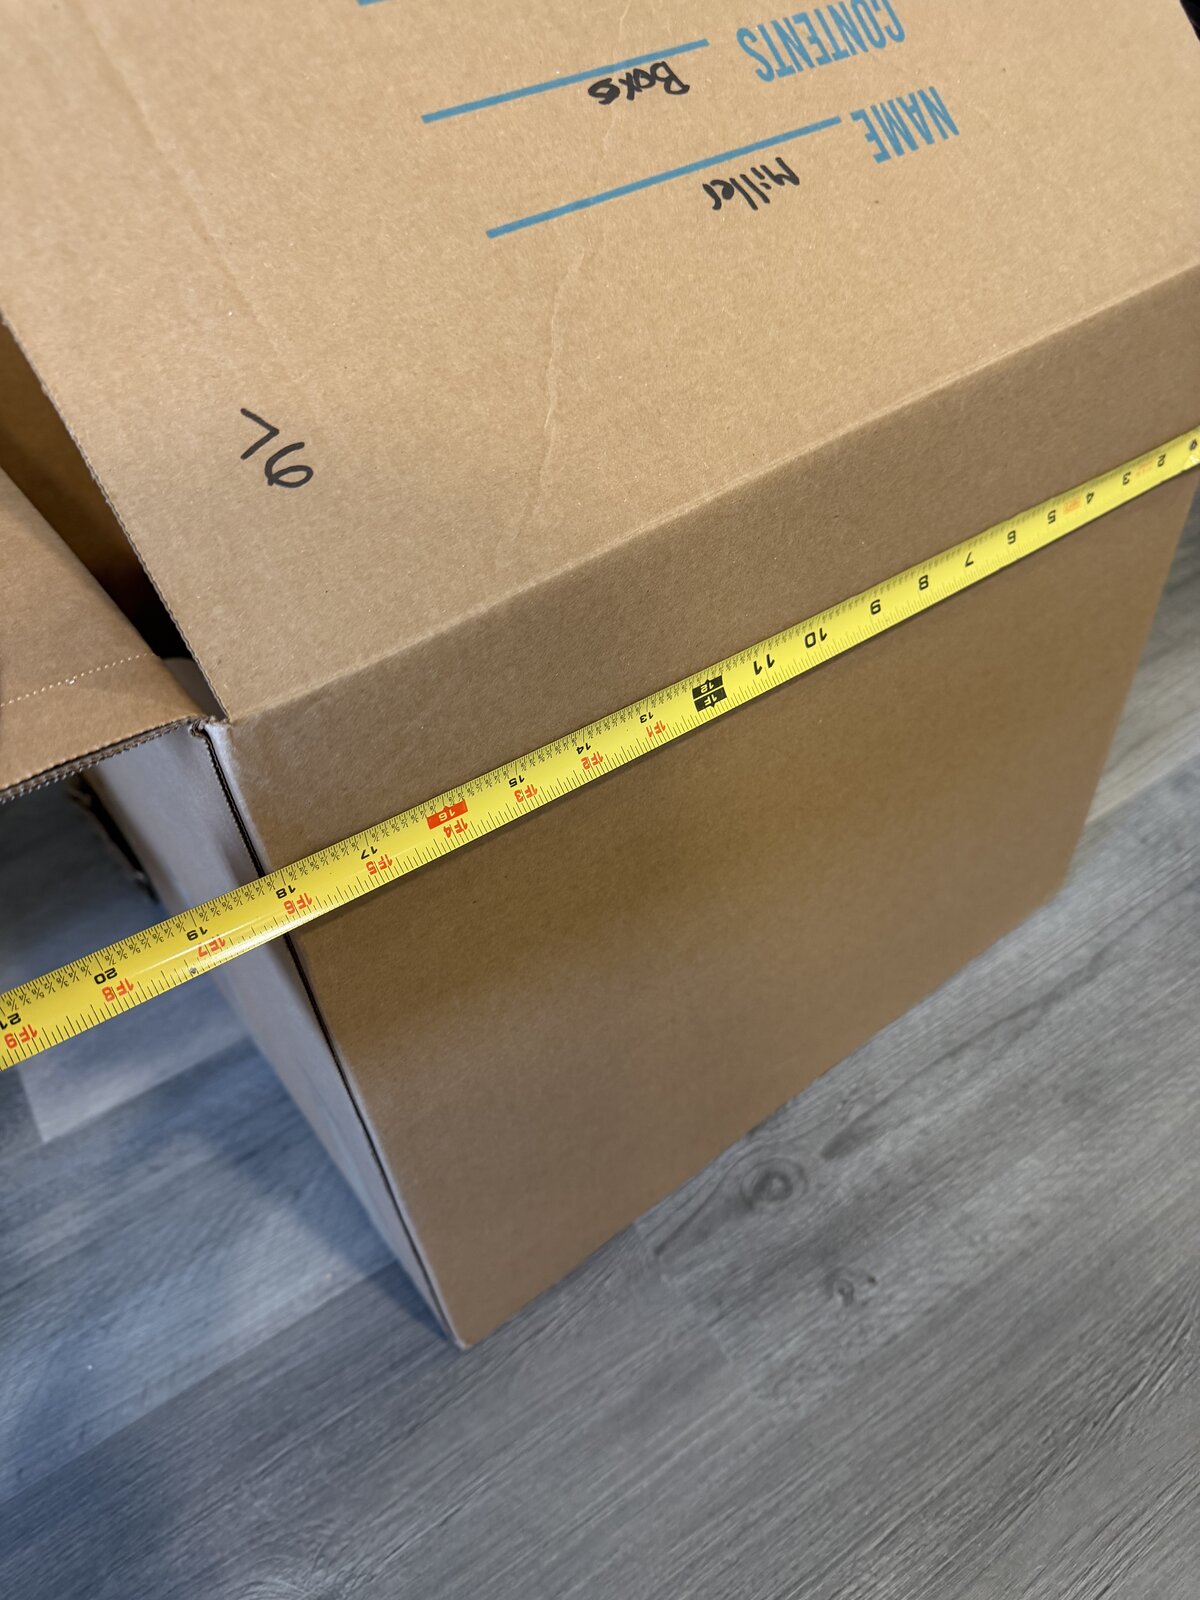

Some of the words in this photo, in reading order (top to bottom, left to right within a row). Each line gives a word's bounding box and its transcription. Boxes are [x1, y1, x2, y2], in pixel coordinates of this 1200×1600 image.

[736, 0, 905, 82] CONTENTS
[850, 86, 960, 164] NAME
[702, 157, 800, 211] Miller
[1157, 454, 1166, 467] 2
[1122, 471, 1131, 485] 3
[1086, 492, 1094, 504] 4
[1047, 509, 1056, 524] 5
[1007, 530, 1016, 545] 6
[965, 552, 974, 567] 7
[918, 574, 929, 590] 8
[870, 599, 882, 615] 9
[804, 628, 828, 648] 10
[753, 654, 775, 676] 11
[700, 682, 715, 694] 12
[704, 694, 718, 706] 1F
[639, 711, 654, 724] 13
[576, 743, 591, 755] 14
[508, 775, 525, 788] 15
[438, 809, 456, 821] 16
[361, 846, 378, 860] 17
[276, 885, 296, 899] 18
[186, 926, 208, 941] 19
[93, 967, 118, 985] 20
[0, 1013, 21, 1030] 21
